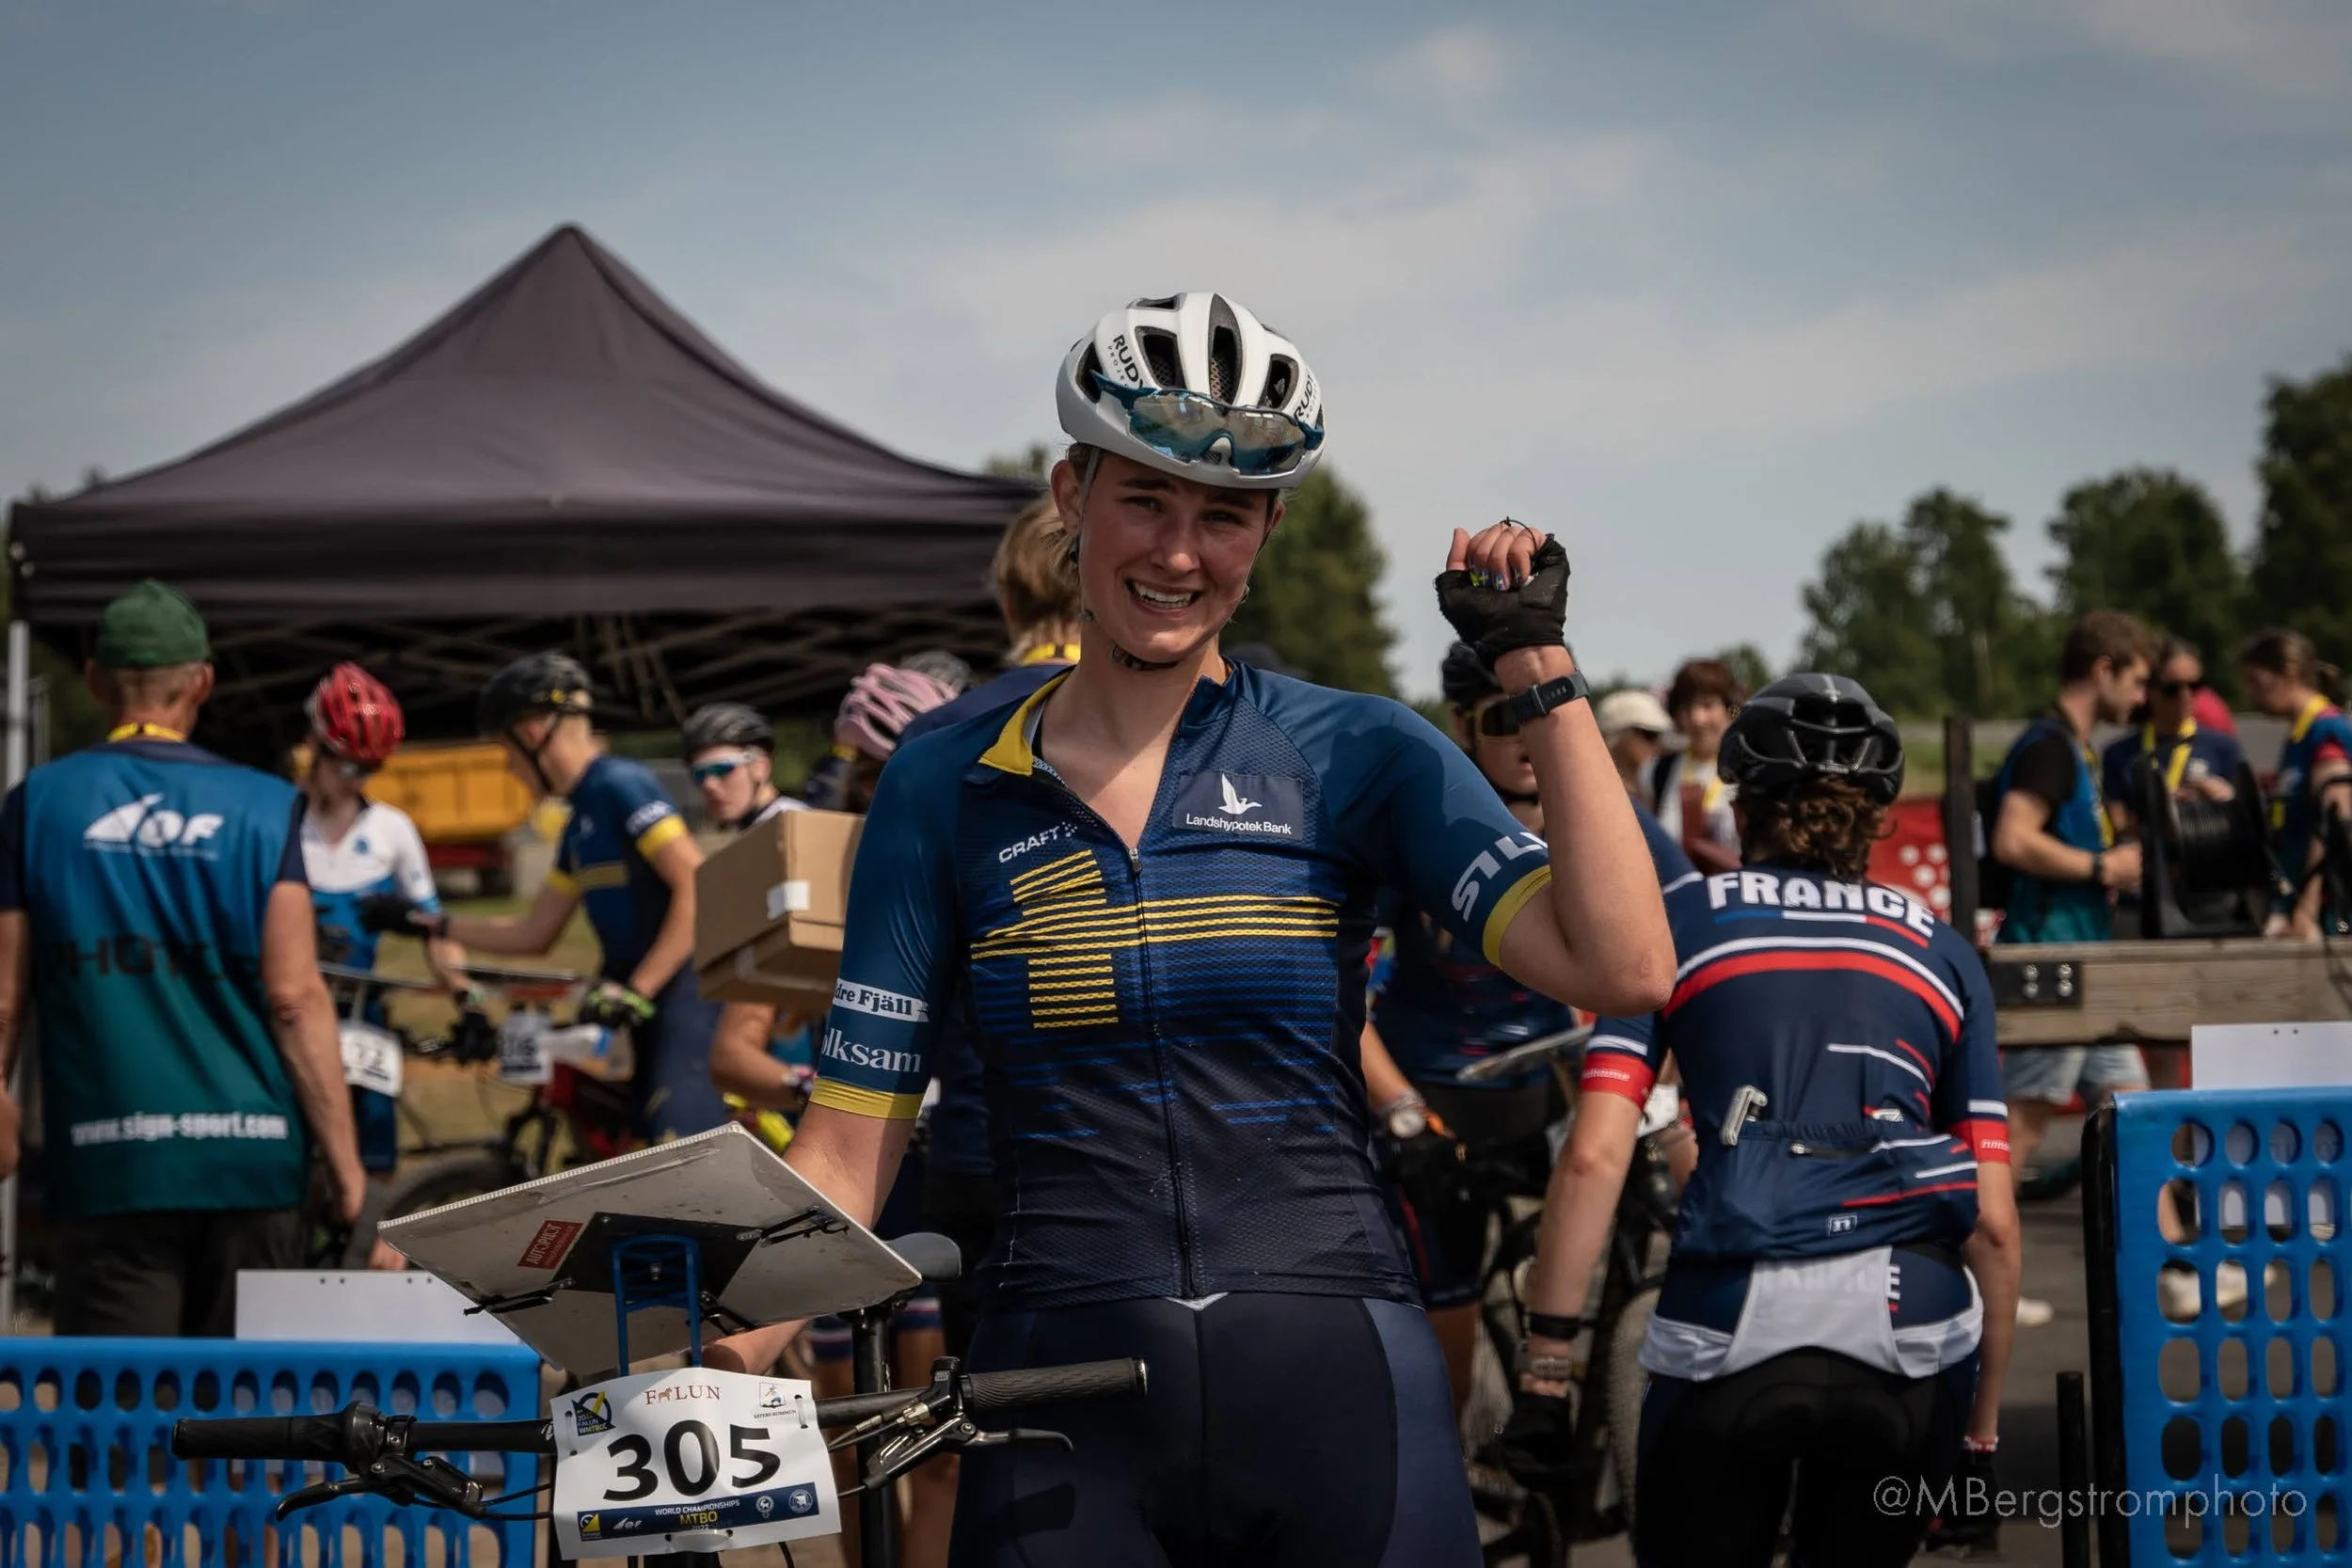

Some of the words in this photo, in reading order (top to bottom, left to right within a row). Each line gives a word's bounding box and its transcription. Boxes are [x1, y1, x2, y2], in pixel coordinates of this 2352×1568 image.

[1185, 814, 1263, 832] Landshypotek
[1263, 821, 1292, 835] Bank
[998, 825, 1060, 863] CRAFT
[1707, 870, 1935, 939] FRANCE
[835, 984, 856, 1003] dre
[857, 989, 913, 1016] Fjäll
[821, 1027, 922, 1073] olksam
[644, 1385, 721, 1405] FLUN
[602, 1419, 781, 1501] 305
[655, 1506, 681, 1516] WORLD
[682, 1499, 741, 1513] CHAMPIONSHIPS
[679, 1512, 719, 1525] MTBO
